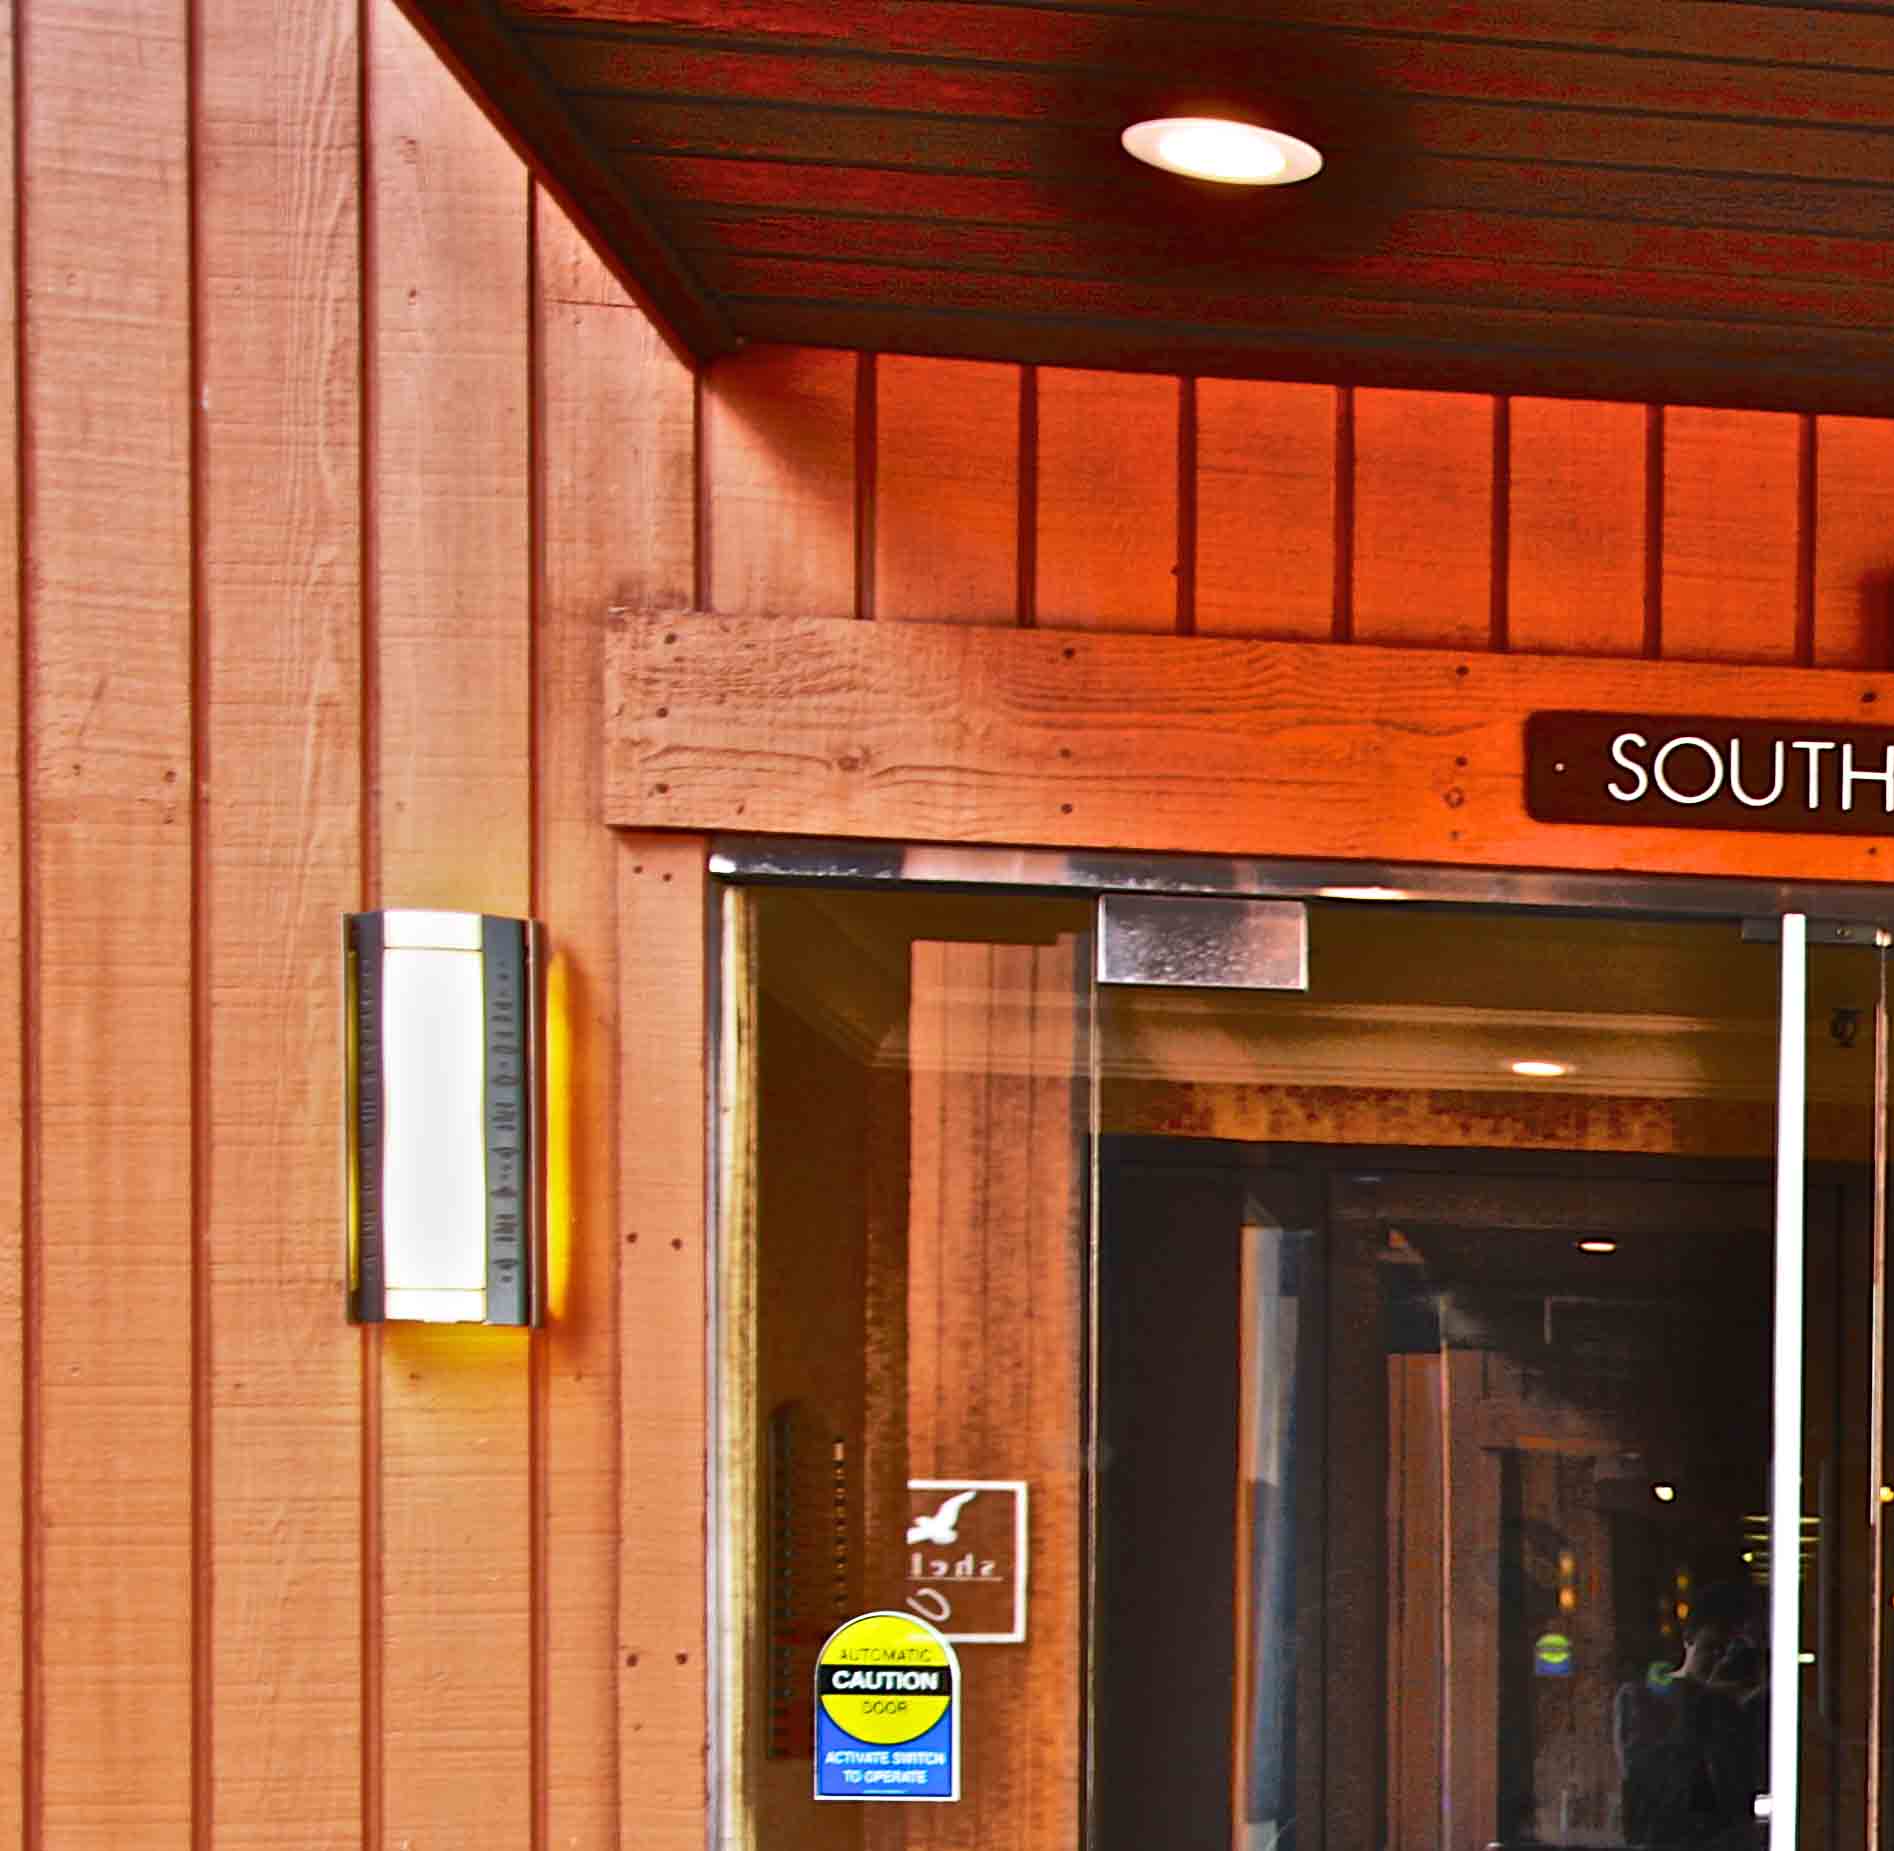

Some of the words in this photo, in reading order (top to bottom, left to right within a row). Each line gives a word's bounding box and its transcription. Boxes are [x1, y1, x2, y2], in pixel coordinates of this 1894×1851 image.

[840, 1648, 932, 1662] AUTOMATIC
[831, 1670, 938, 1690] CAUTION
[862, 1700, 908, 1715] DOOR
[825, 1751, 889, 1765] ACTIVATE
[891, 1751, 945, 1766] SWITCH
[842, 1769, 861, 1783] TO
[863, 1770, 928, 1784] OPERATE
